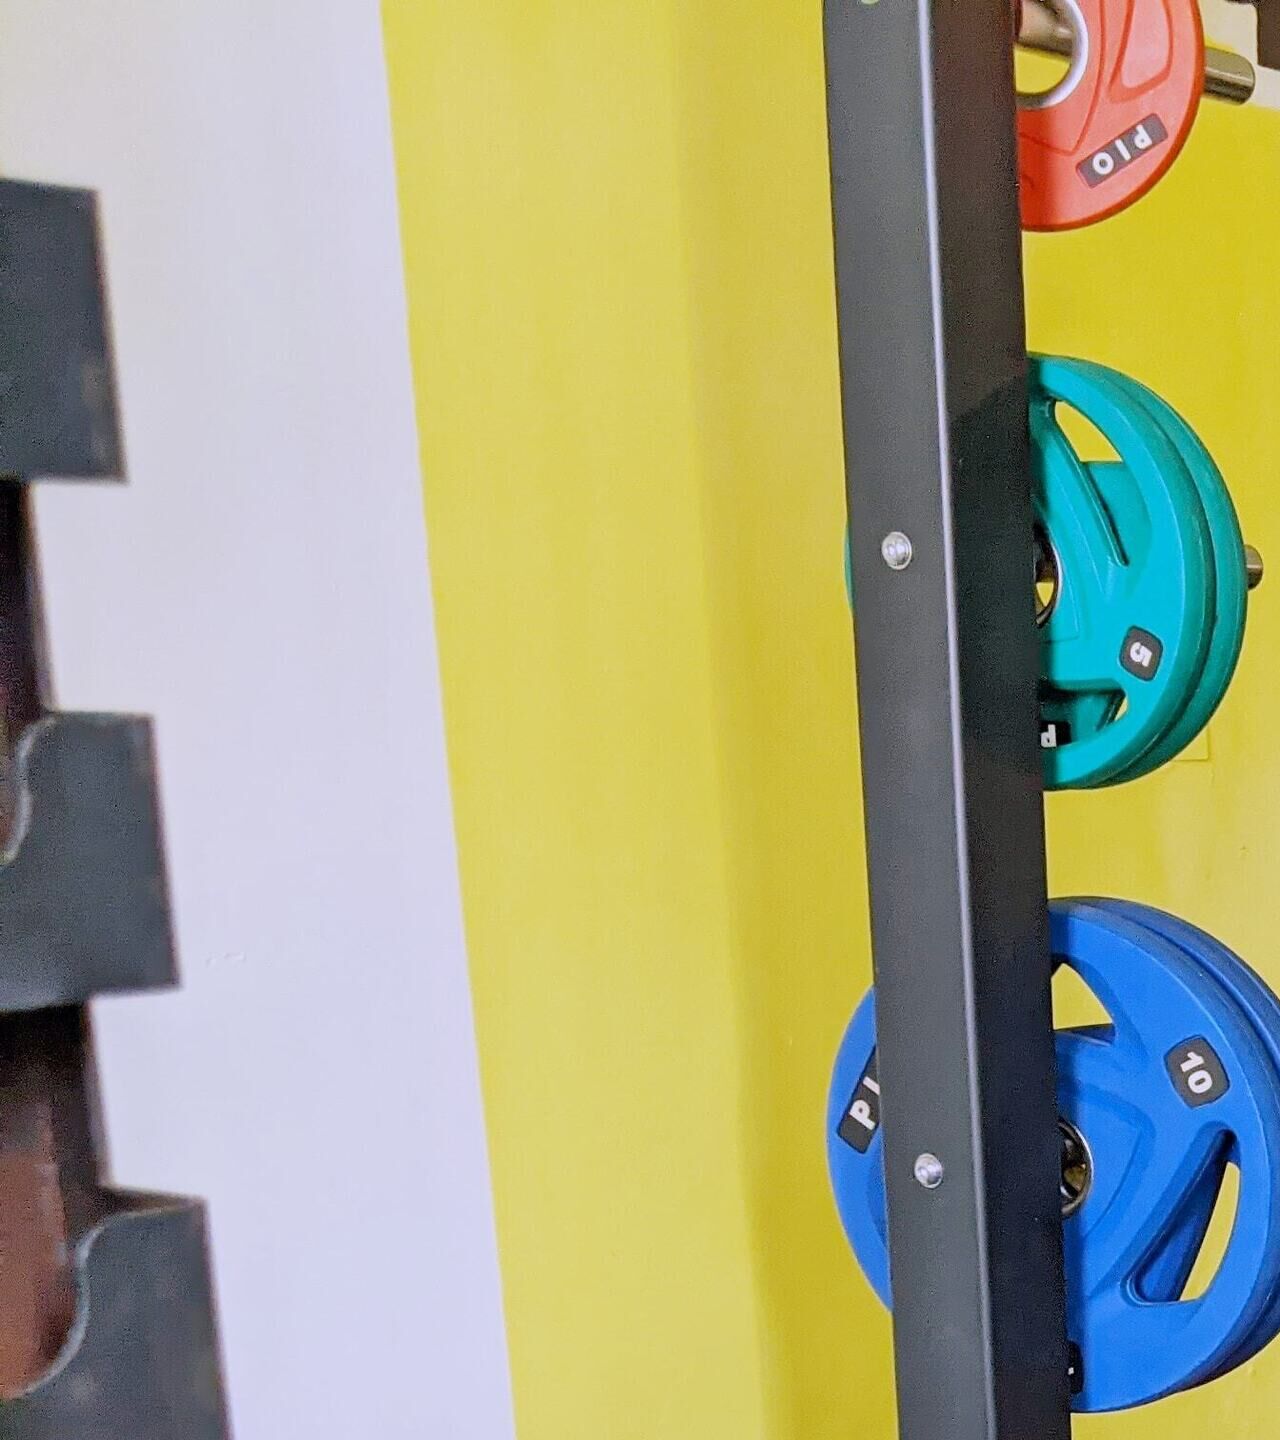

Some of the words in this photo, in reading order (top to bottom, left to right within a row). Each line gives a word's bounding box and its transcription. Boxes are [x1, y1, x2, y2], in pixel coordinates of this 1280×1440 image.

[1091, 124, 1153, 175] PIO
[1129, 641, 1153, 668] 5
[1180, 1051, 1213, 1094] 10
